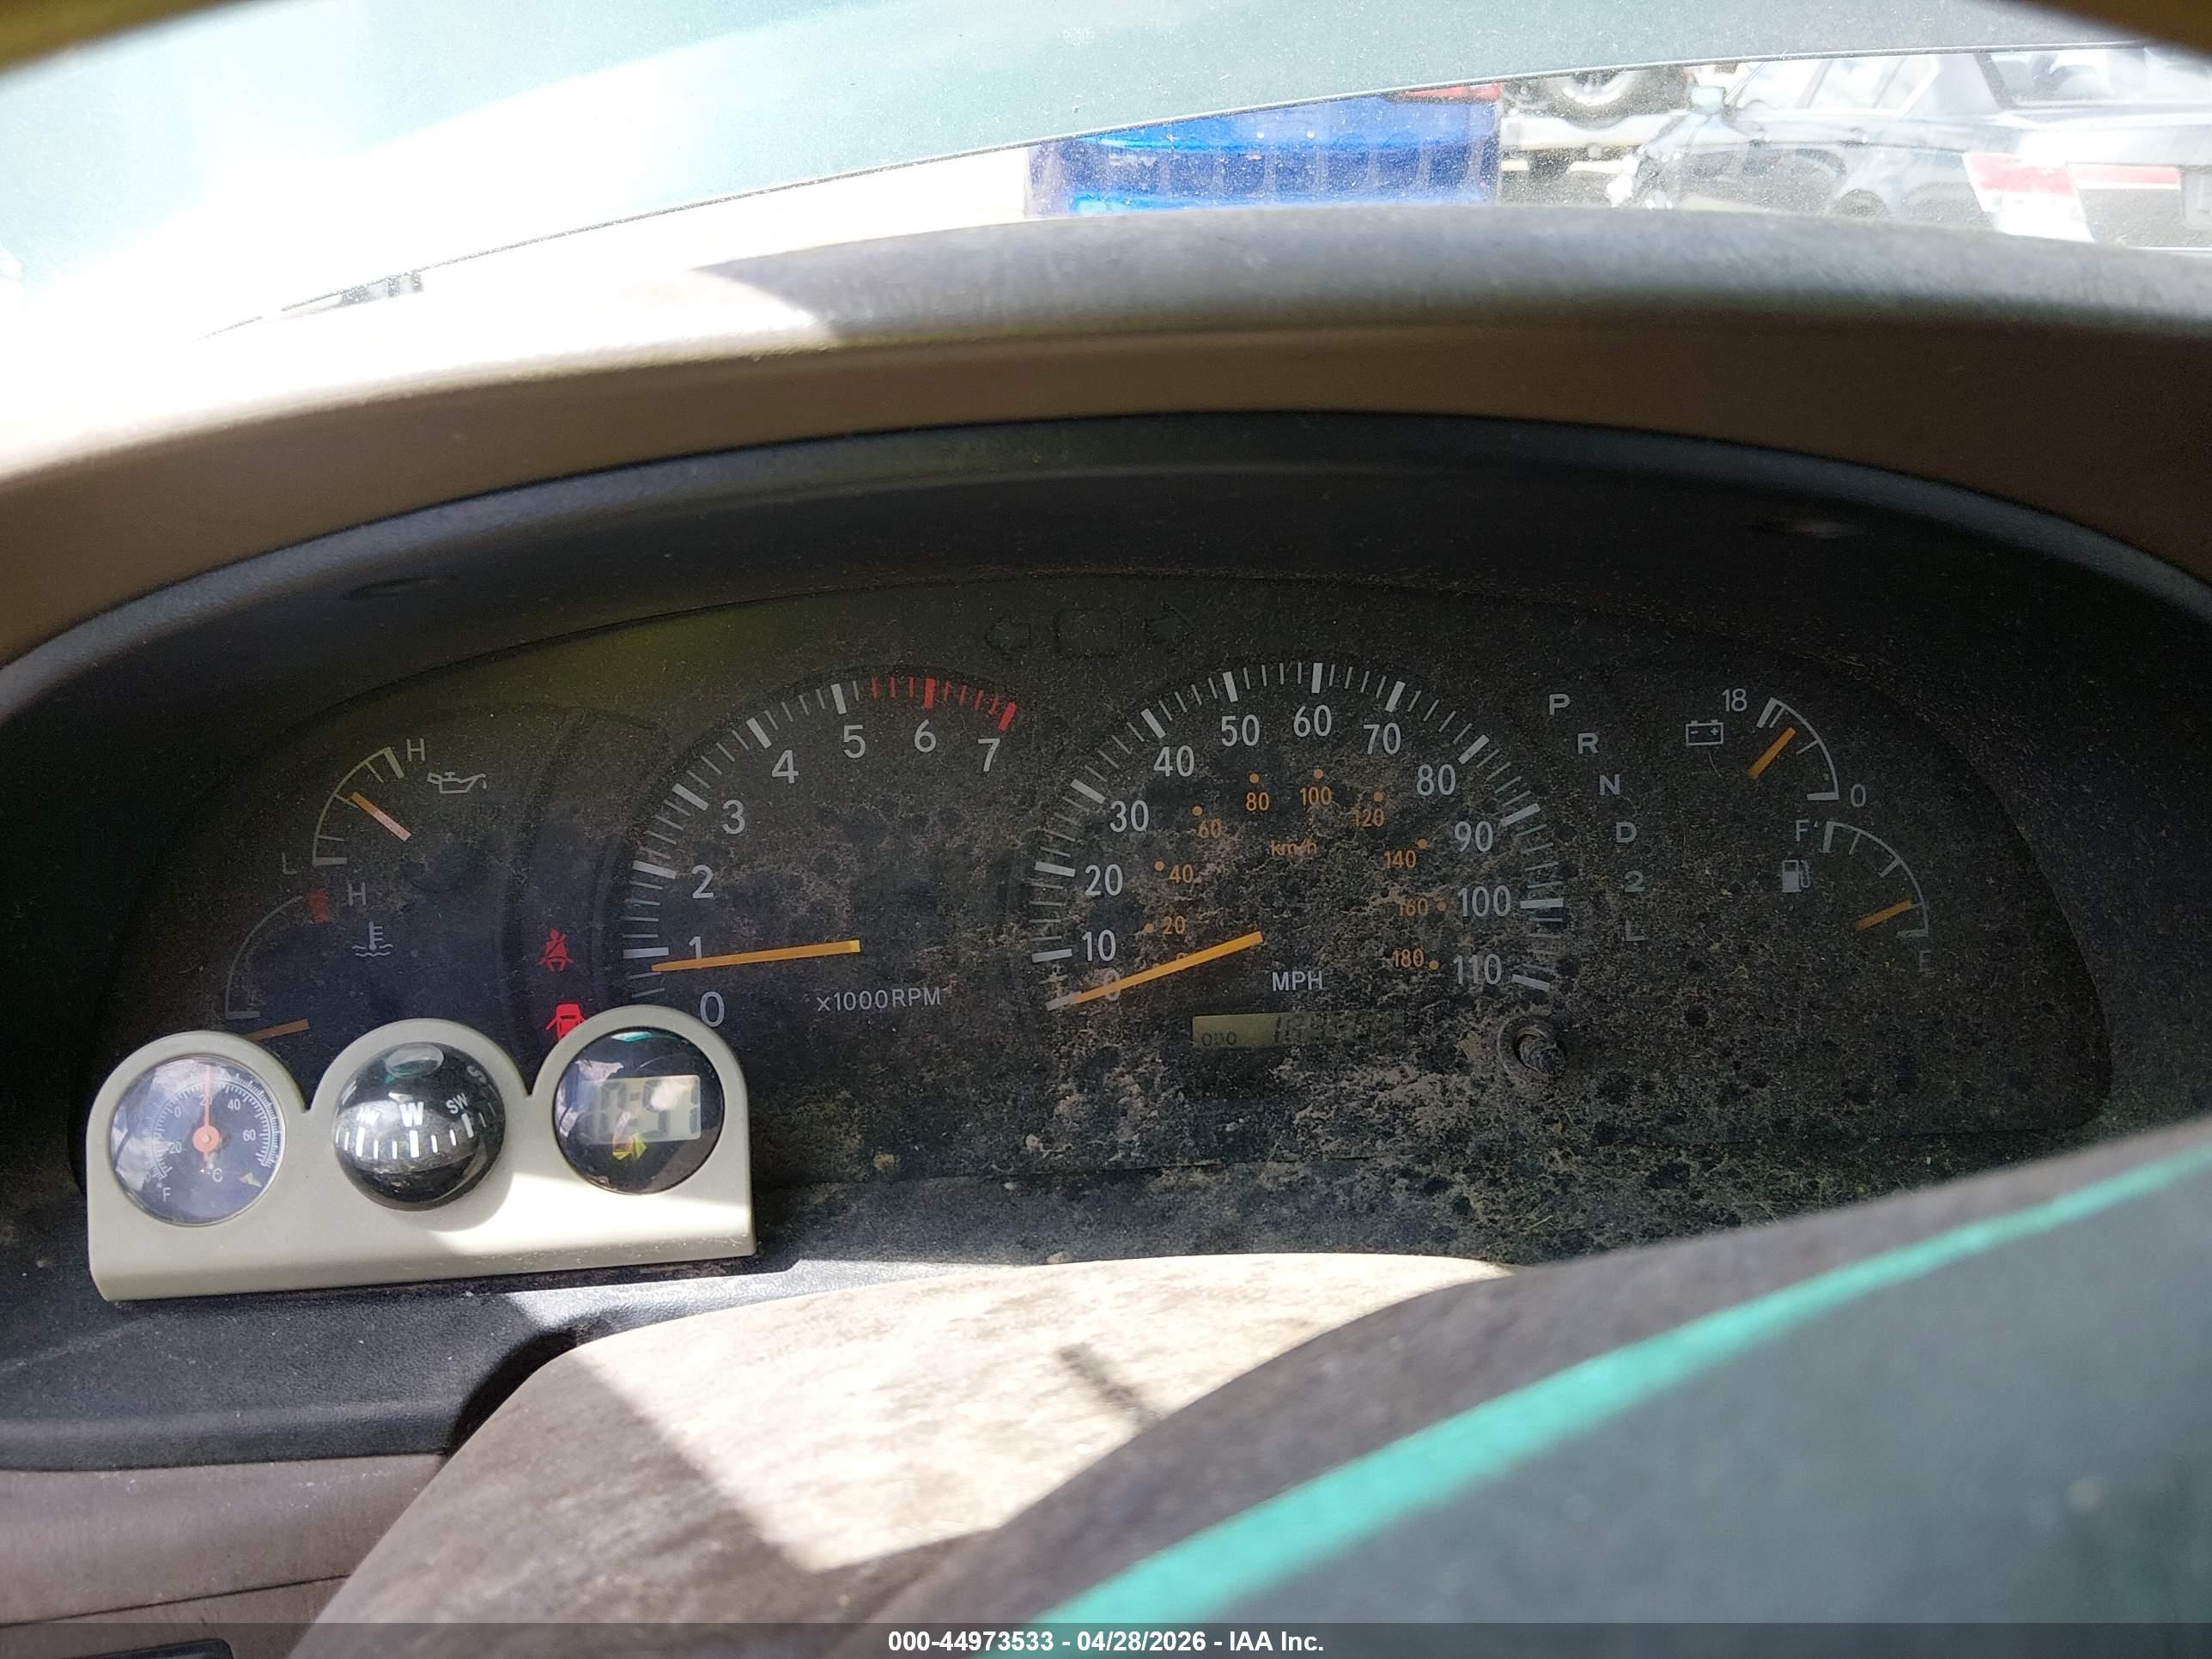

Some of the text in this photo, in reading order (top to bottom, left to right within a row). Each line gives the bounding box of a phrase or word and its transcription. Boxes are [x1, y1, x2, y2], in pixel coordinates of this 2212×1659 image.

[1549, 694, 1571, 715] P
[1722, 689, 1747, 712] 18
[1221, 714, 1260, 746] 50
[1293, 705, 1332, 737] 60
[843, 725, 866, 758] 5
[915, 720, 936, 752] 6
[1364, 722, 1401, 755] 70
[1577, 732, 1599, 754] R
[406, 738, 426, 762] H
[978, 738, 1000, 771] 7
[1153, 745, 1194, 777] 40
[772, 750, 799, 783] 4
[1417, 764, 1455, 796] 80
[1600, 774, 1621, 795] N
[1245, 792, 1270, 811] 80
[1300, 786, 1333, 806] 100
[722, 799, 744, 834] 3
[1110, 799, 1149, 832] 30
[1353, 808, 1385, 828] 120
[1199, 818, 1222, 839] 60
[1455, 821, 1492, 852] 90
[1616, 822, 1638, 843] D
[1796, 820, 1809, 842] F
[282, 852, 297, 874] L
[1384, 850, 1417, 869] 140
[692, 866, 714, 898] 2
[1085, 865, 1123, 896] 20
[1170, 865, 1194, 884] 40
[1625, 871, 1644, 892] 2
[348, 883, 366, 906] H
[1457, 885, 1510, 917] 100
[1398, 898, 1429, 917] 160
[1163, 916, 1186, 935] 20
[689, 936, 702, 969] 1
[1081, 929, 1116, 961] 10
[1392, 948, 1424, 968] 180
[1454, 953, 1501, 985] 110
[1273, 971, 1323, 992] MPH
[700, 992, 724, 1027] 0
[467, 1065, 488, 1084] S
[228, 1098, 240, 1110] 40
[399, 1102, 424, 1127] W
[447, 1092, 469, 1115] SW
[243, 1129, 256, 1141] 60
